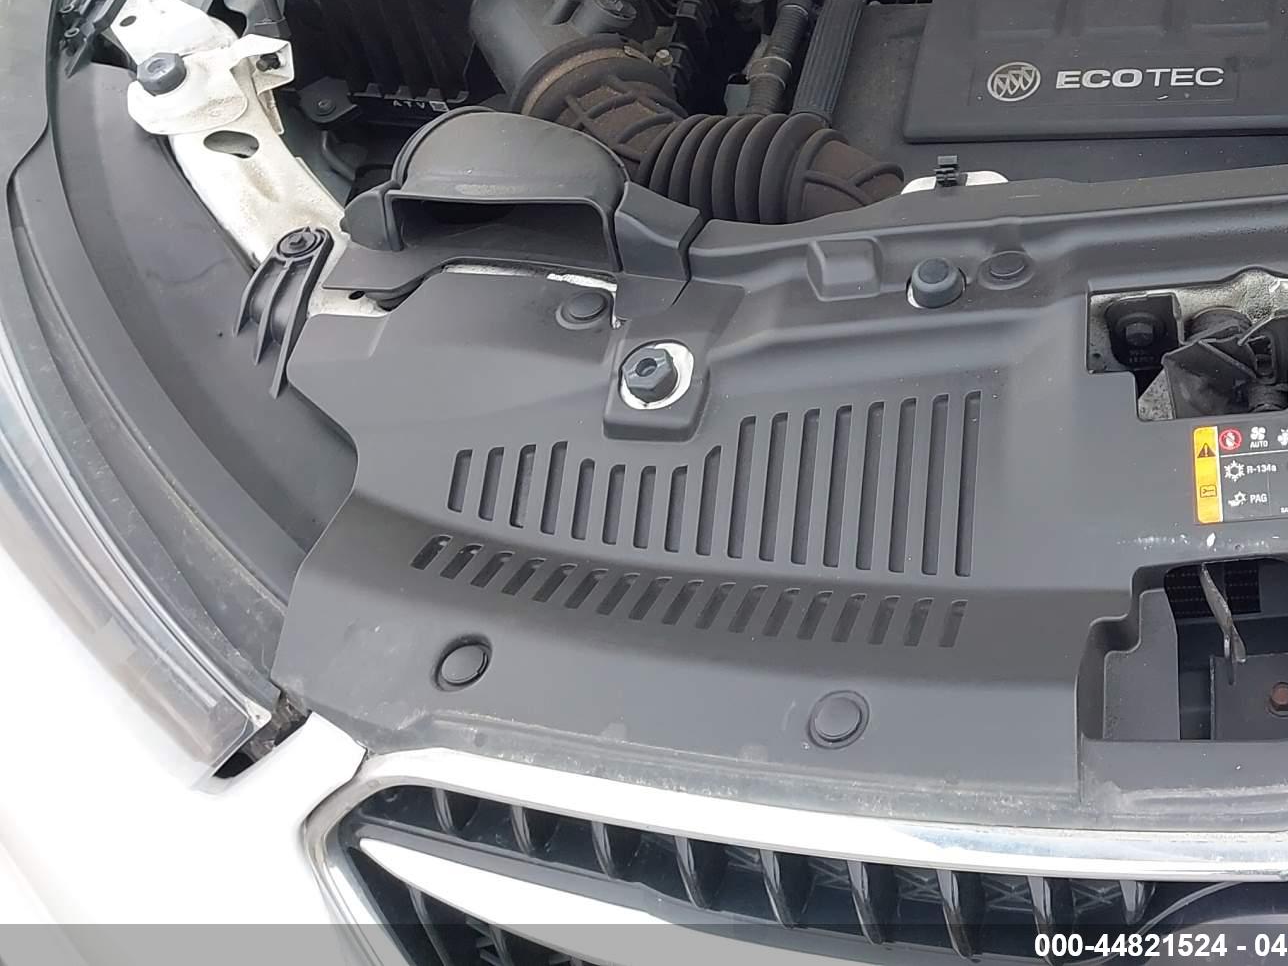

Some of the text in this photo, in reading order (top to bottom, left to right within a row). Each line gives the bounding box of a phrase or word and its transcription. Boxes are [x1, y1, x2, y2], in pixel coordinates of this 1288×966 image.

[1056, 67, 1225, 89] ECOTEC
[1249, 440, 1269, 449] AUTO
[1246, 463, 1277, 474] R-134a
[1249, 493, 1268, 504] PAG
